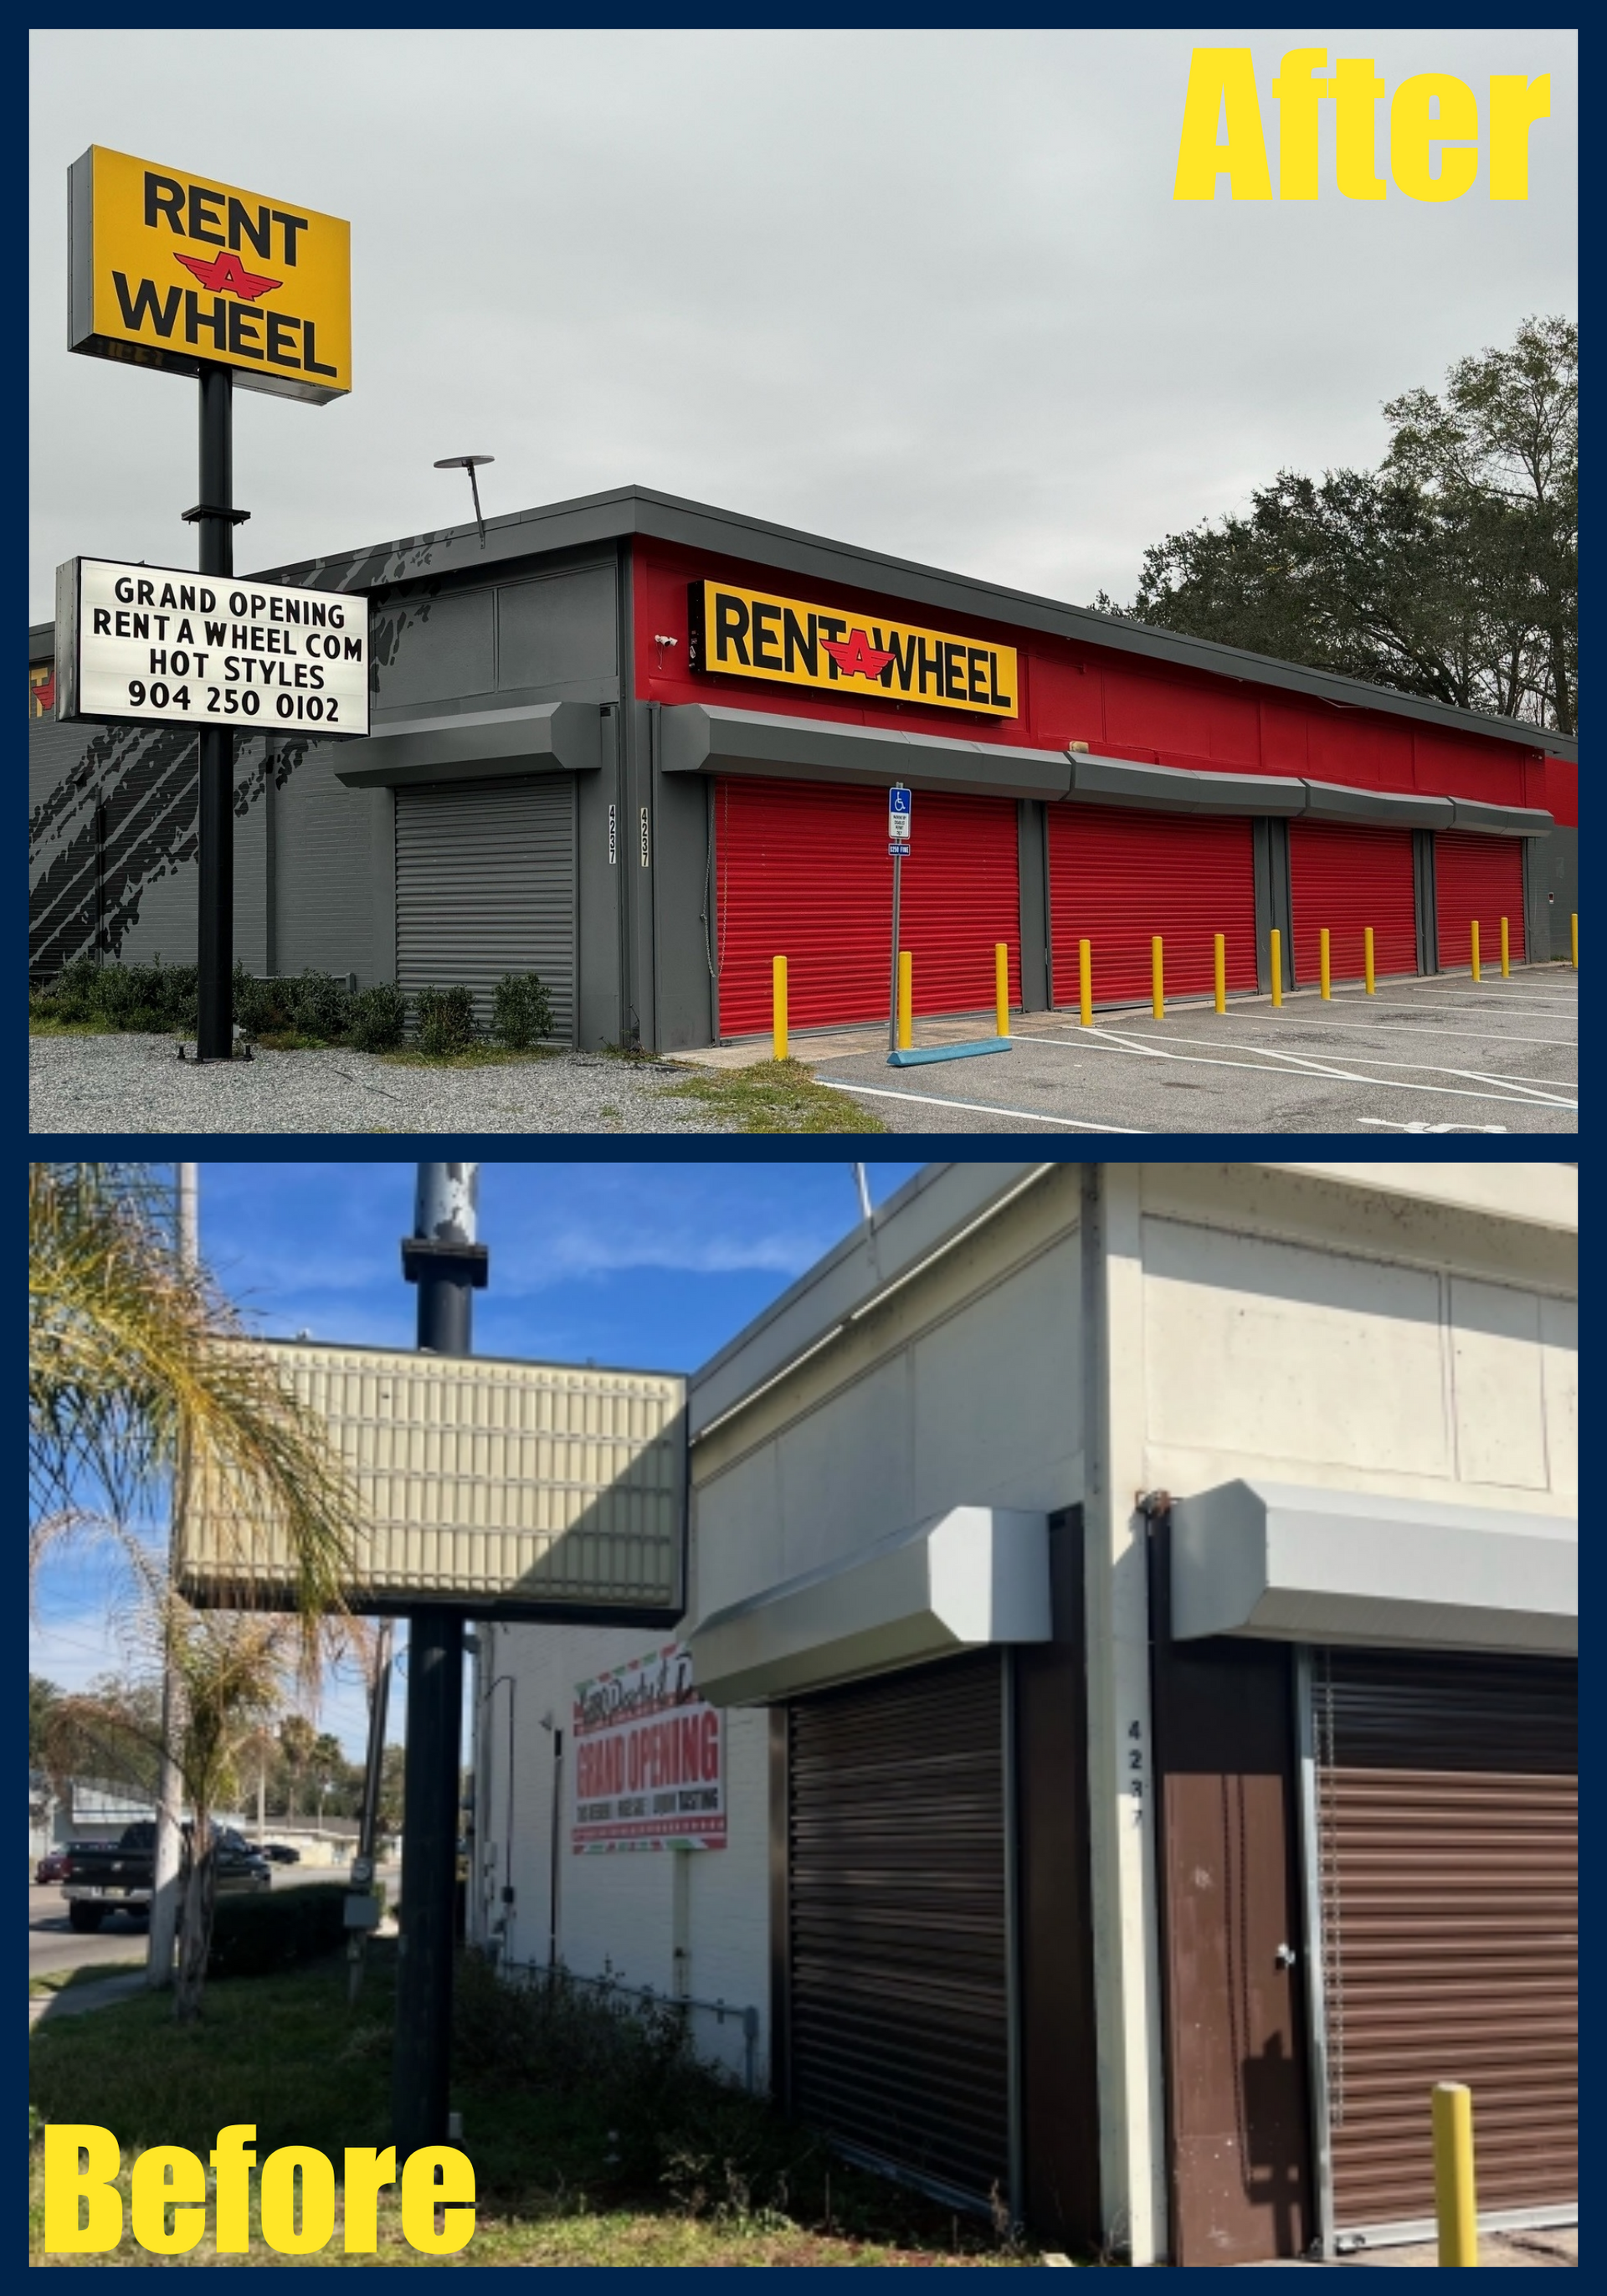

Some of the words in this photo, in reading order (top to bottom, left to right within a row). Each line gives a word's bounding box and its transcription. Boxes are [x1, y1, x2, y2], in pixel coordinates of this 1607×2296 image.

[144, 171, 308, 267] RENT
[111, 270, 337, 378] WHEEL
[93, 608, 170, 641] RENT
[177, 619, 195, 645] A
[204, 621, 297, 655] WHEEL
[305, 634, 362, 662] COM
[115, 577, 217, 614] GRAND
[228, 592, 345, 629] OPENING
[149, 648, 209, 678] HOT
[223, 656, 325, 690] STYLES
[716, 593, 846, 681] RENT
[872, 628, 1011, 708] WHEEL
[128, 681, 191, 711] 904
[206, 686, 260, 716] 250
[276, 693, 339, 722] 0102
[578, 1735, 624, 1799] GRAND
[629, 1710, 717, 1792] OPENING
[1128, 1720, 1142, 1829] 4237
